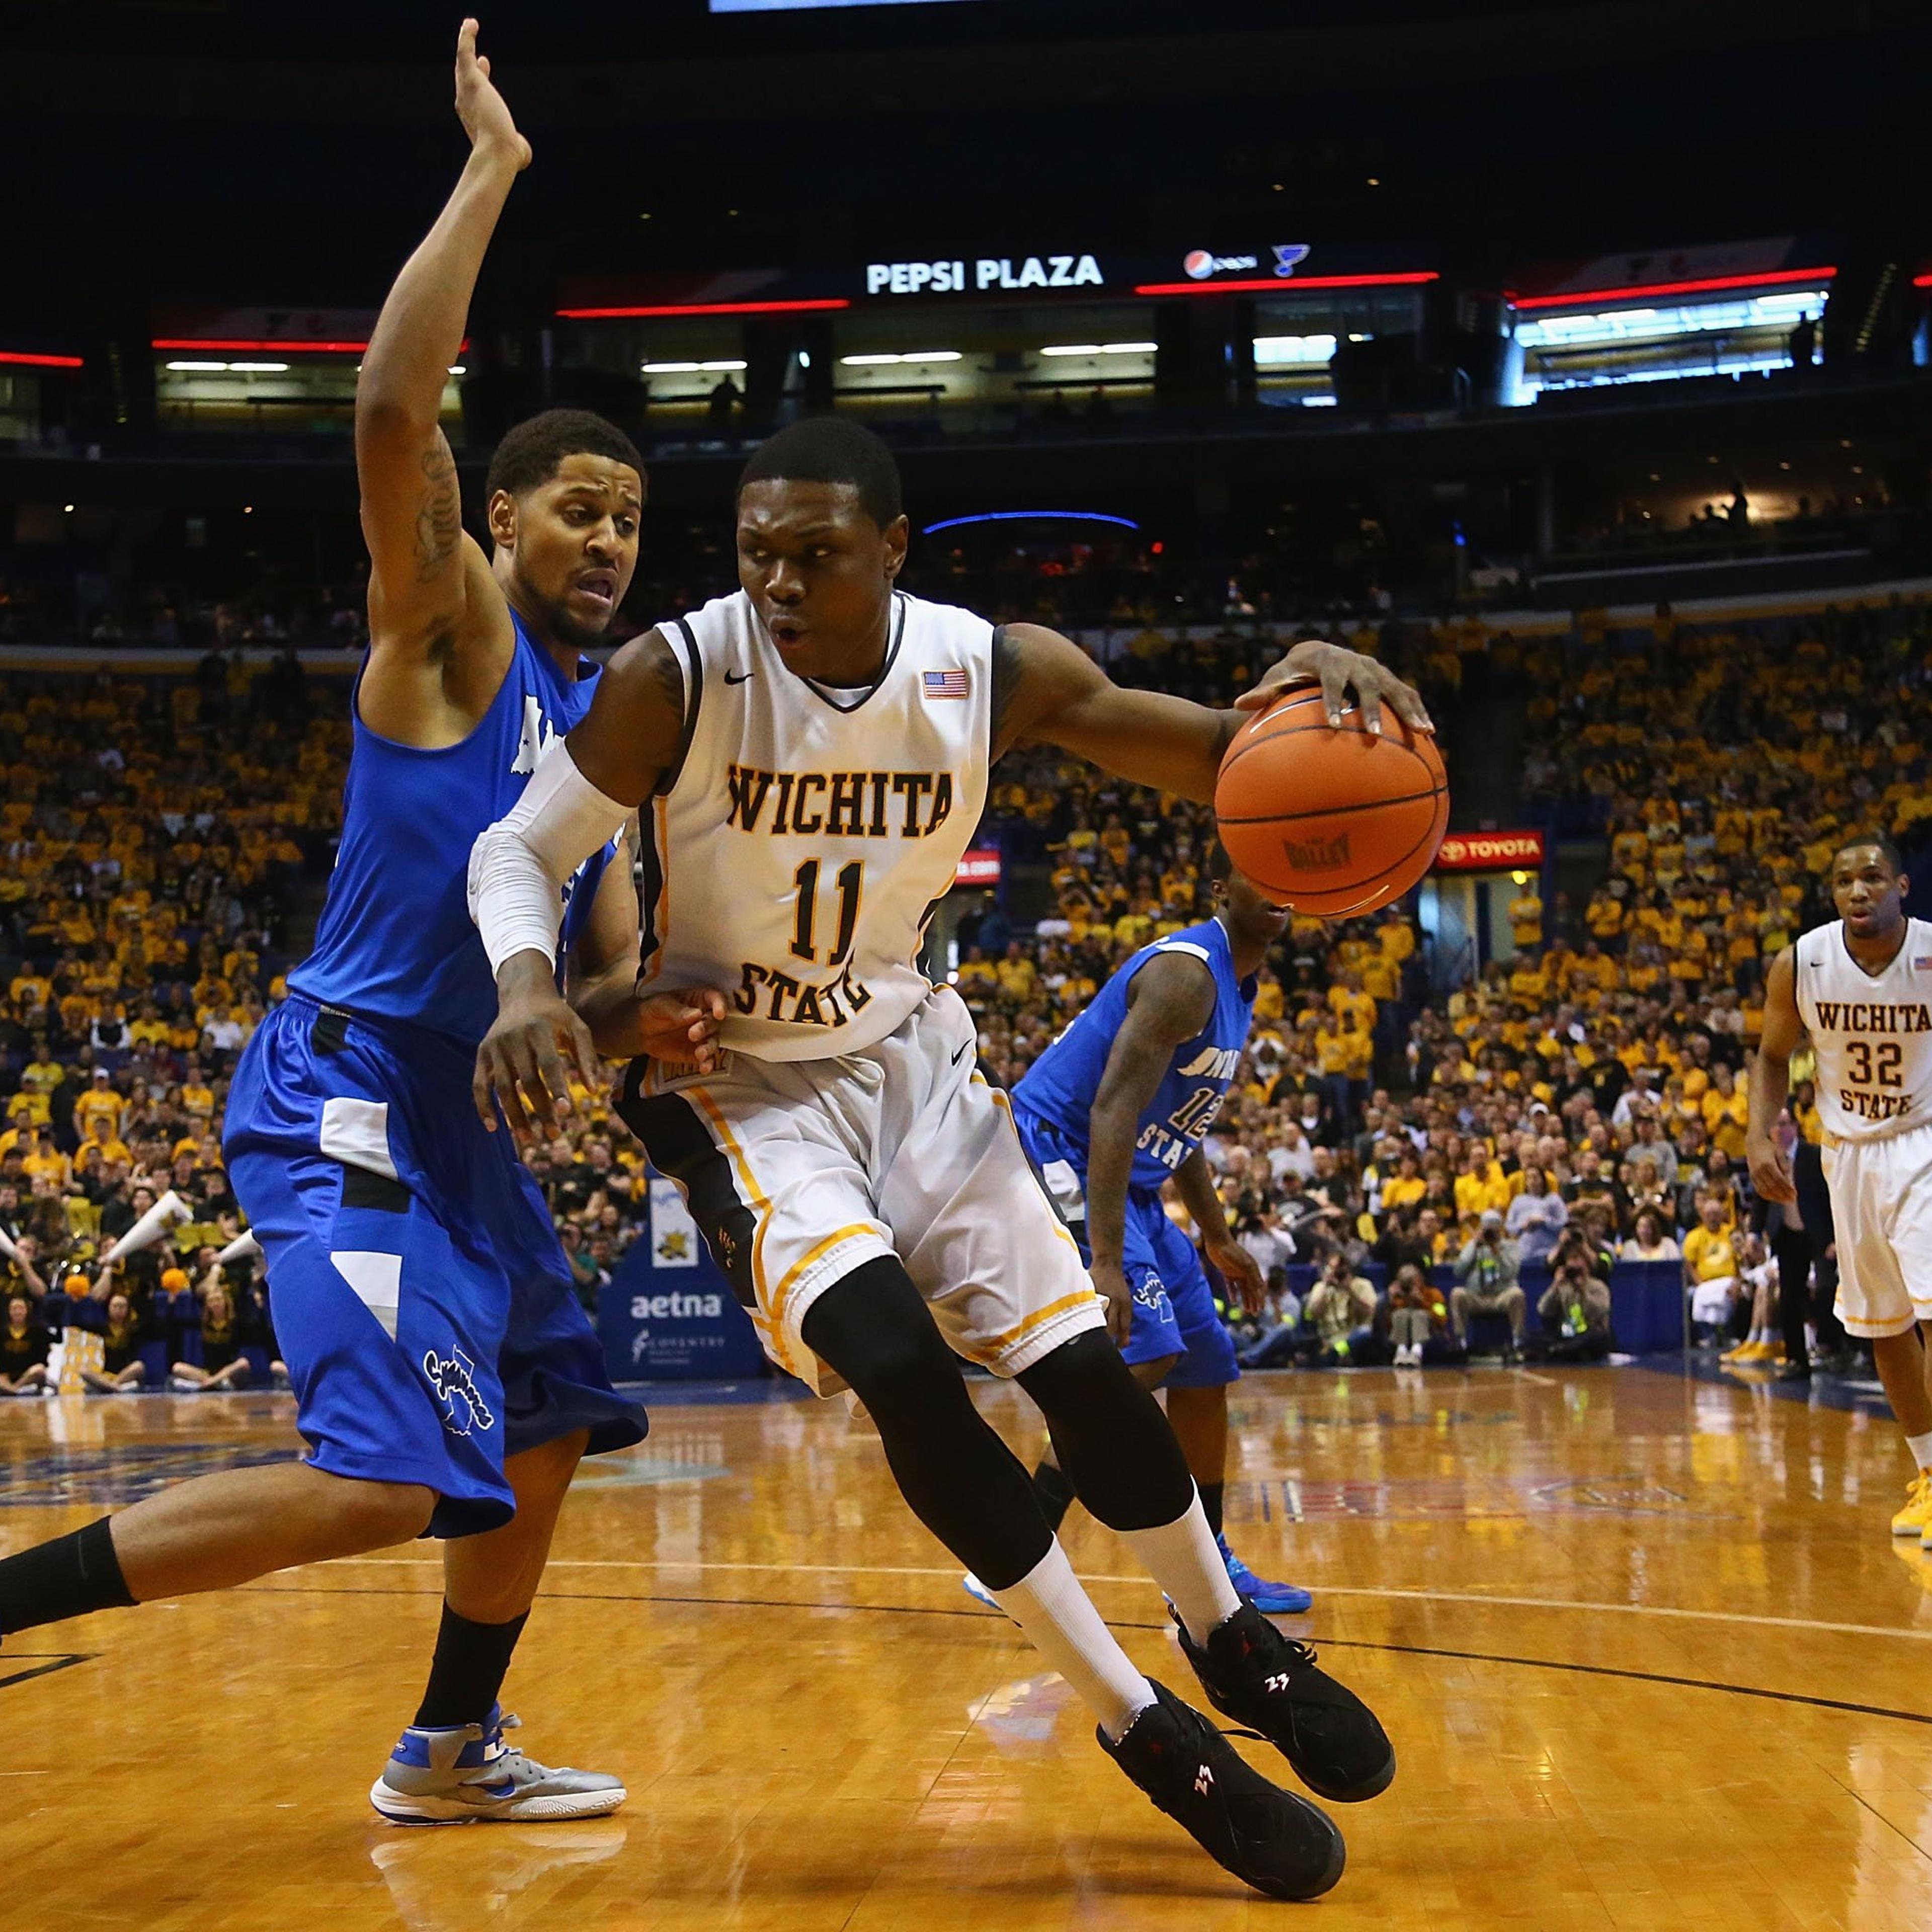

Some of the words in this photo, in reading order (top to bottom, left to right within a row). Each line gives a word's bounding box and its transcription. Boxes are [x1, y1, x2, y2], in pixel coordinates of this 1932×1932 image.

[867, 261, 964, 294] PEPSI
[976, 255, 1104, 289] PLAZA
[726, 764, 953, 839] WICHITA
[1467, 838, 1541, 858] TOYOTA
[788, 857, 865, 968] 11
[1815, 1001, 1932, 1032] WICHITA
[1845, 1041, 1902, 1088] 32
[1839, 1088, 1913, 1119] STATE
[1136, 1122, 1193, 1170] STA
[630, 1291, 722, 1319] aetna
[1264, 1672, 1290, 1693] 23
[1194, 1764, 1216, 1797] 23
